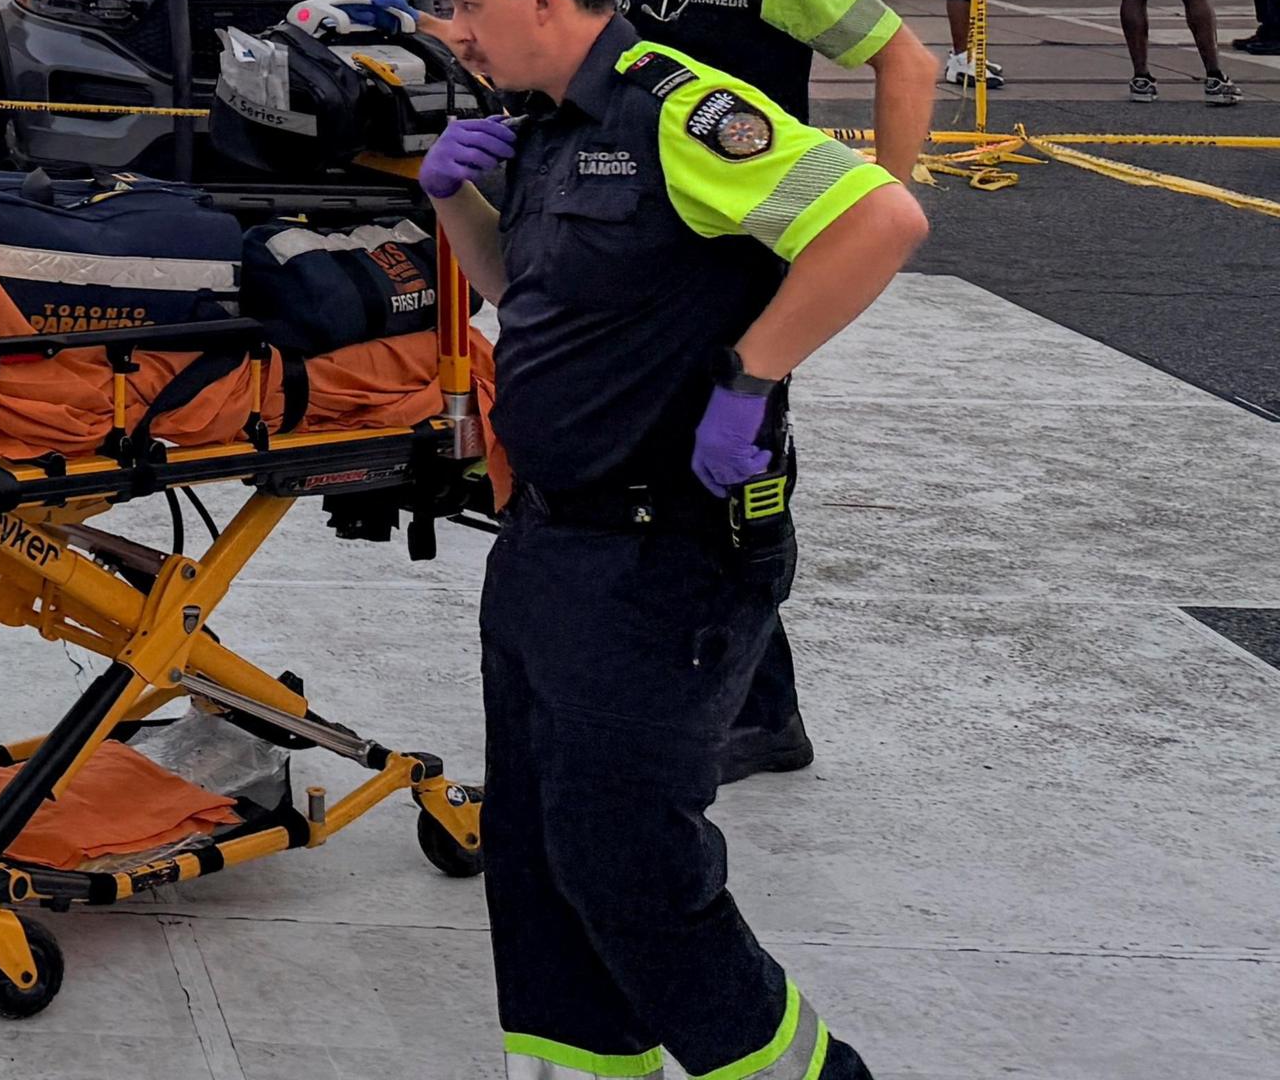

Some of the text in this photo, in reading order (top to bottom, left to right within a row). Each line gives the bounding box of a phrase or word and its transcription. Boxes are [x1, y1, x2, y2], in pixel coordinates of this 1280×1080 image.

[240, 100, 288, 125] Series
[44, 303, 146, 319] TORONTO
[390, 291, 419, 314] FIRST
